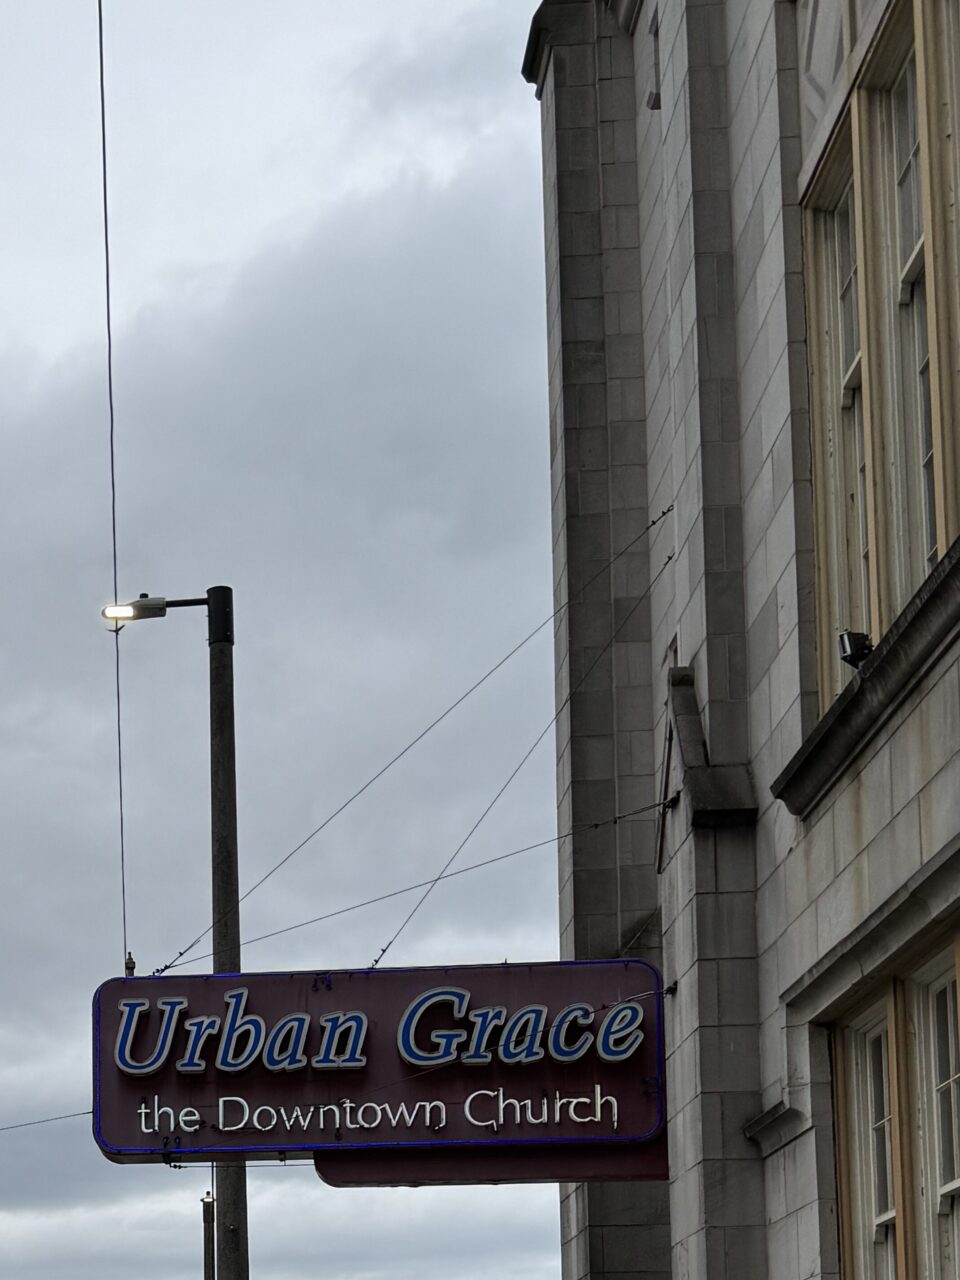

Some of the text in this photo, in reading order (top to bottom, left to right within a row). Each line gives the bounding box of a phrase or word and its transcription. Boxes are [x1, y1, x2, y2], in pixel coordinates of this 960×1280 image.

[114, 986, 645, 1075] Urban Grace
[137, 1085, 618, 1134] the Downtown Church
